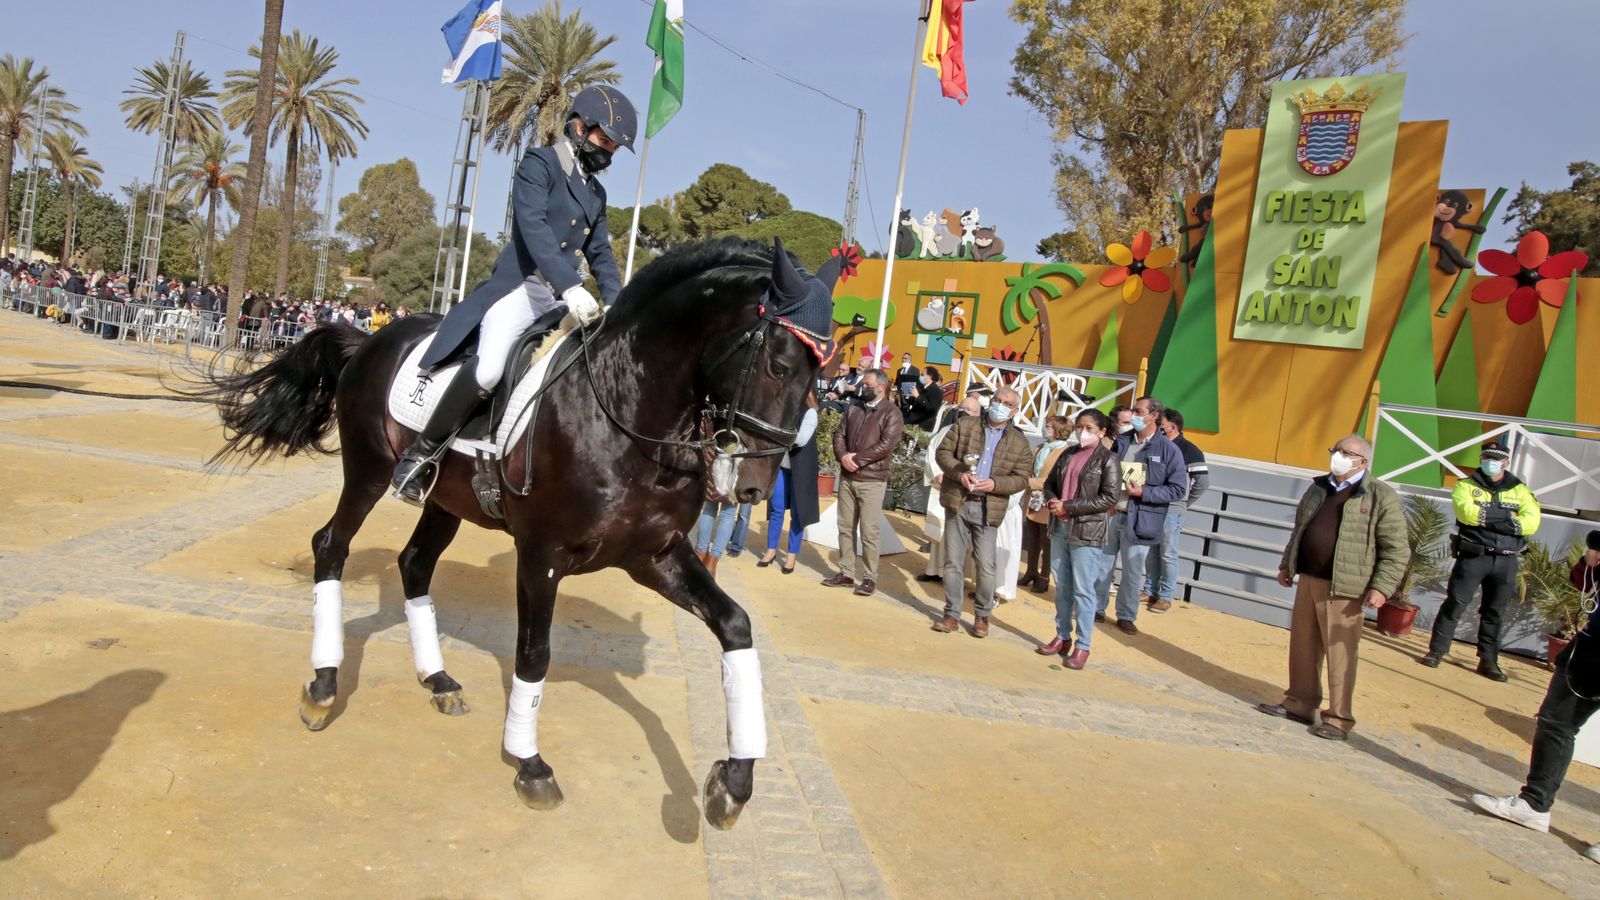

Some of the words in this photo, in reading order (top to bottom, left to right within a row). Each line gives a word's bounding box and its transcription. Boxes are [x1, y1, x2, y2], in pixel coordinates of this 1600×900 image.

[1265, 191, 1366, 223] FIESTA
[1298, 228, 1325, 249] DE
[1273, 255, 1342, 288] SAN
[1244, 290, 1361, 328] ANTON
